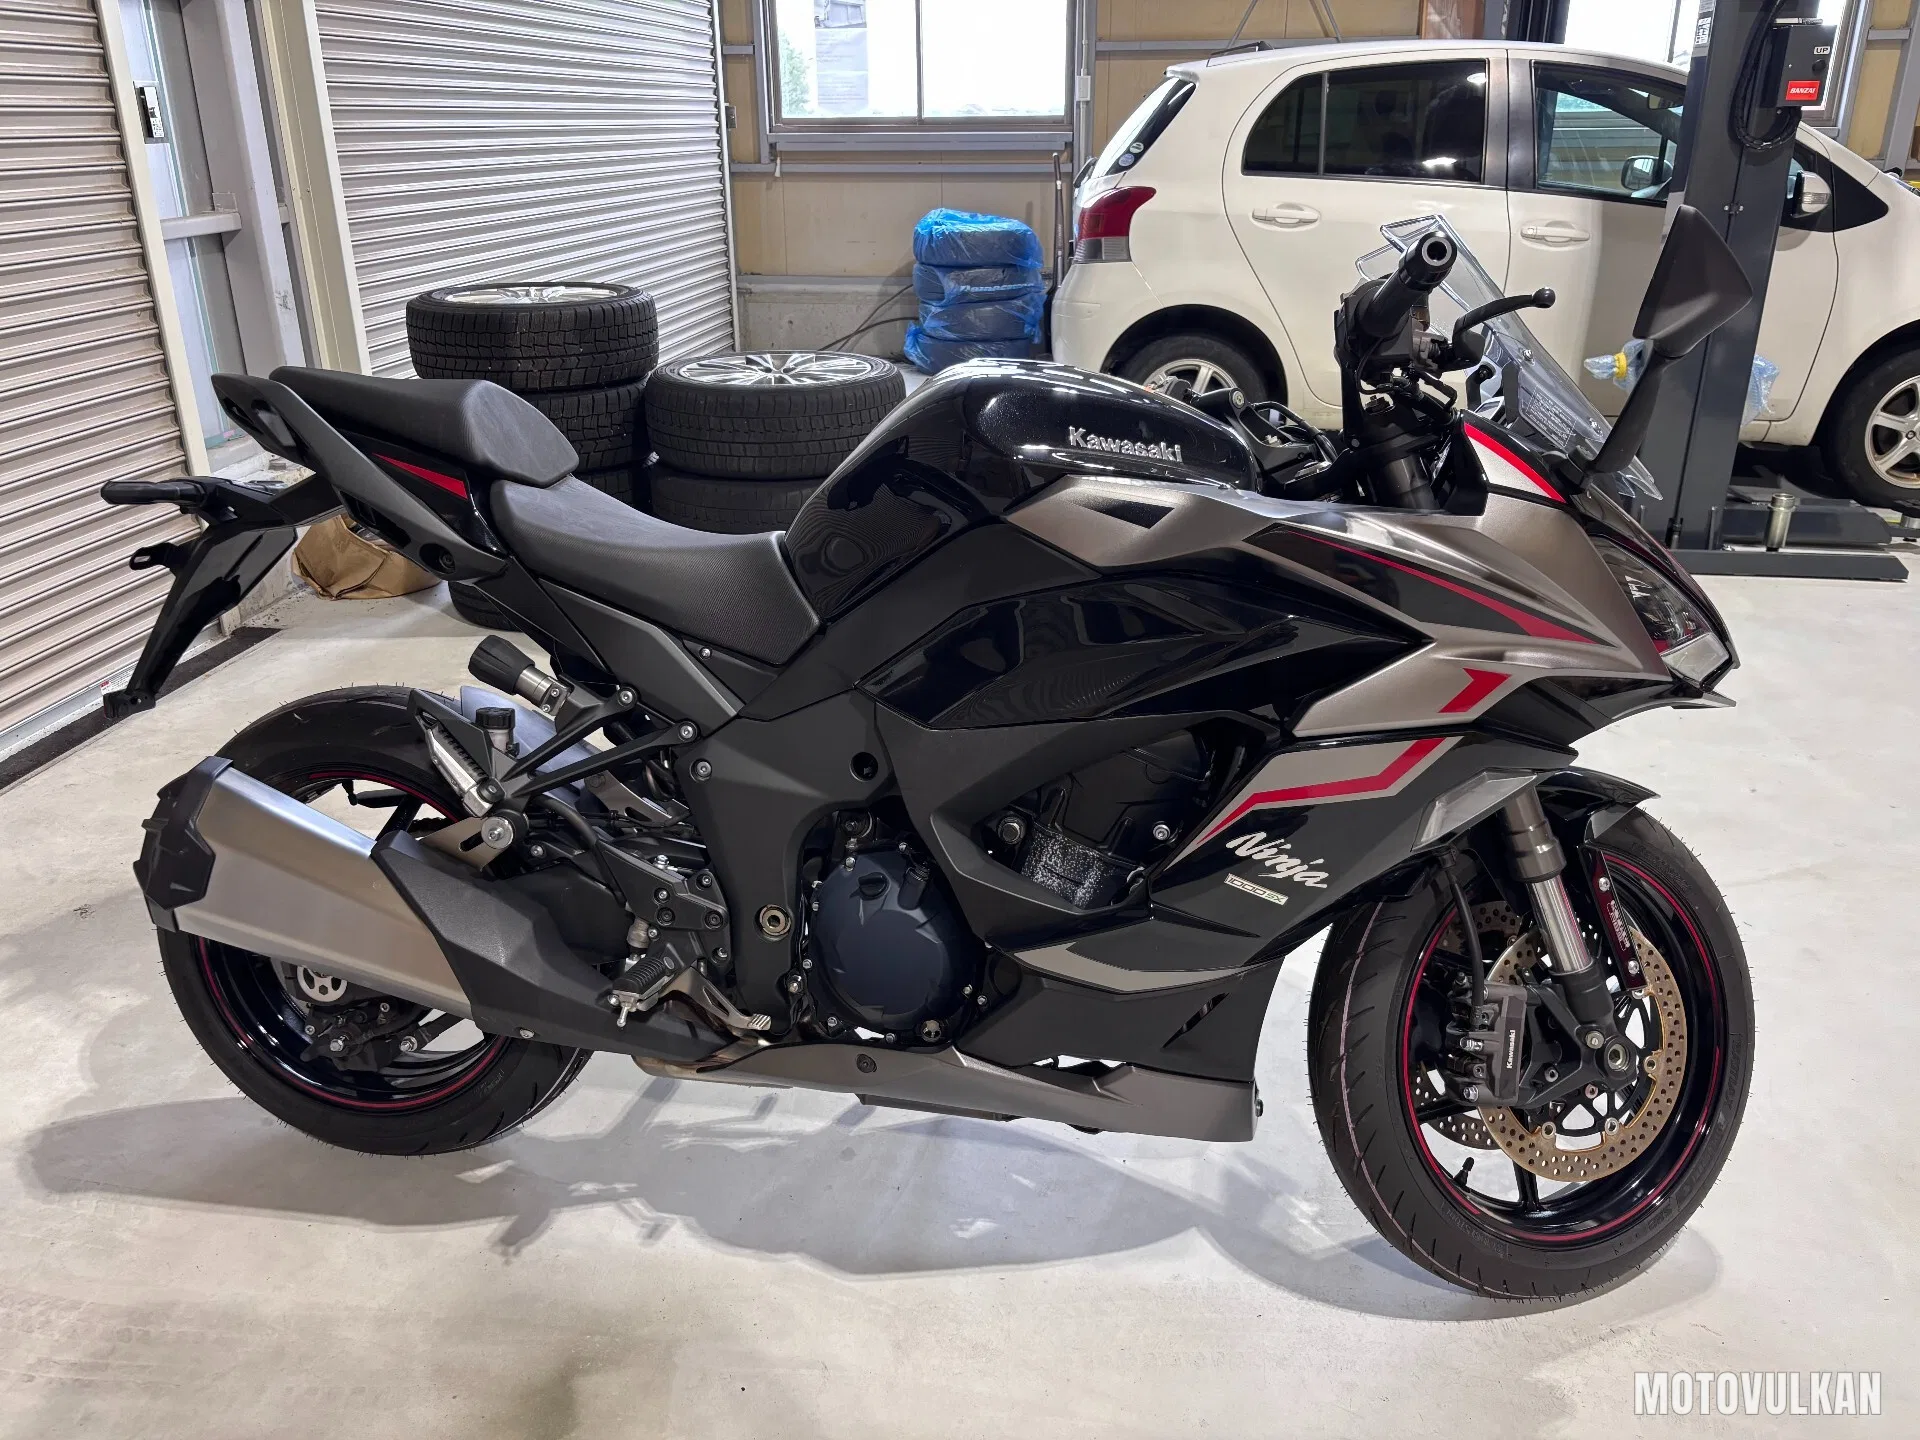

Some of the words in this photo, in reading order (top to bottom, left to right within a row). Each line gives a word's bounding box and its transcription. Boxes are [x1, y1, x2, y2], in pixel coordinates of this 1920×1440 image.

[1068, 425, 1183, 463] Kawasaki
[1225, 831, 1329, 889] Ninja
[1506, 1029, 1516, 1069] Kawasaki
